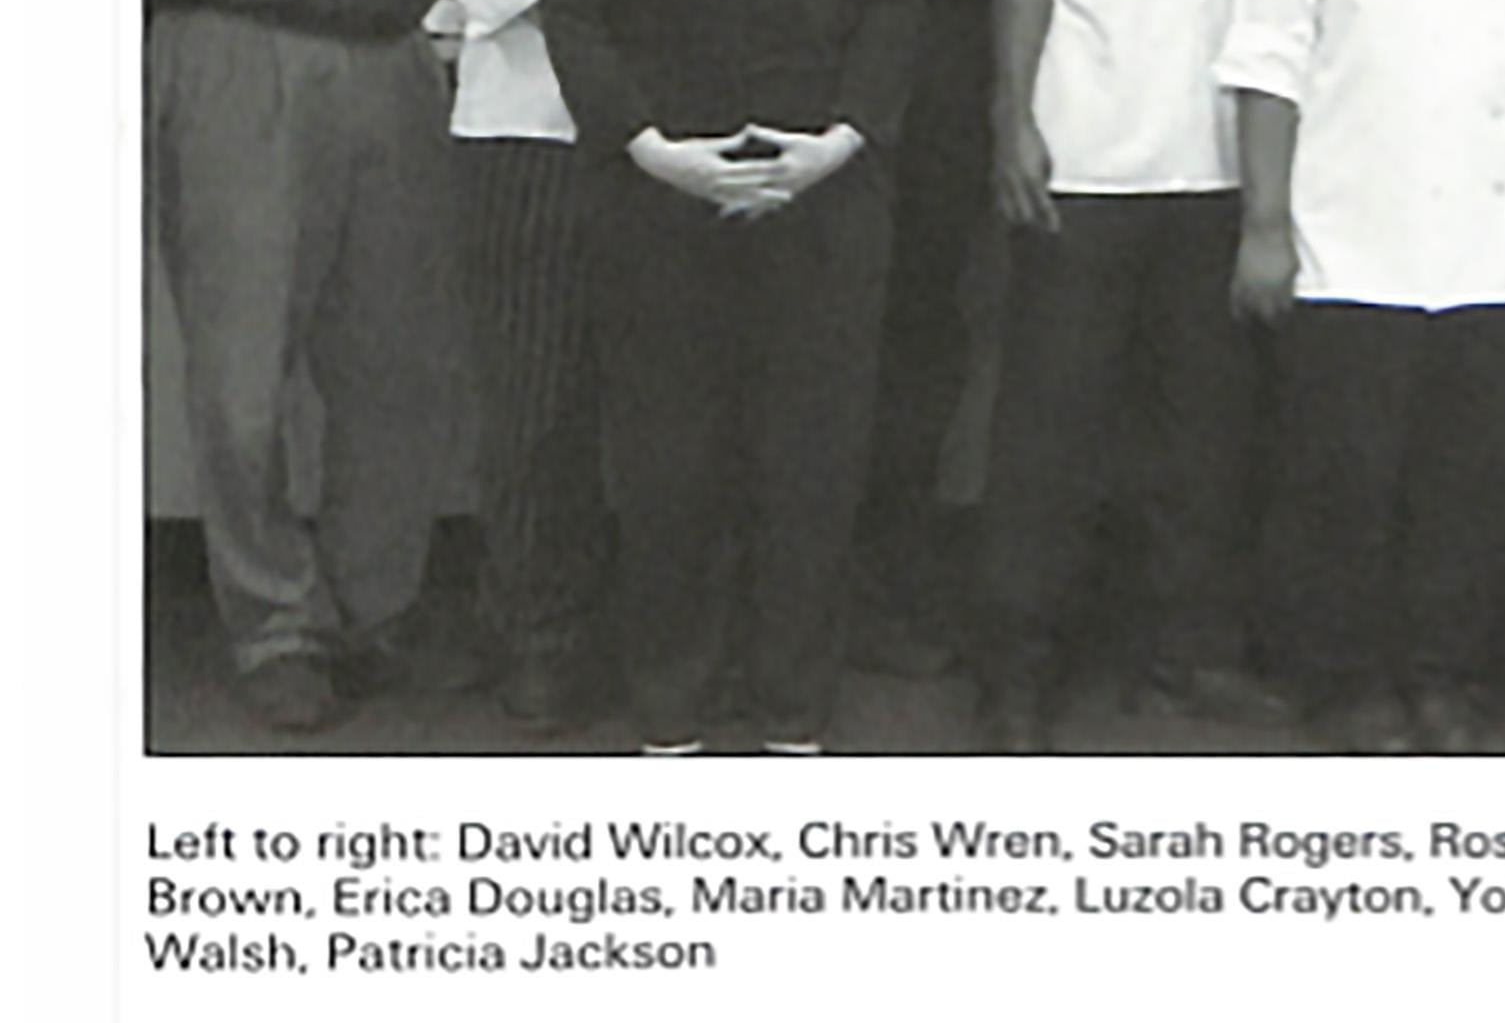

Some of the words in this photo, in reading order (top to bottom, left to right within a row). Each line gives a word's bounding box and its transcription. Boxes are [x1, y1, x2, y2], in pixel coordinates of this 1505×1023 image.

[147, 821, 236, 861] Left
[252, 828, 301, 863] to
[317, 822, 439, 870] right:
[458, 821, 593, 863] David
[607, 821, 783, 862] Wilcox,
[798, 821, 918, 860] Chris
[931, 820, 1073, 862] Wren,
[1089, 820, 1224, 860] Sarah
[1239, 821, 1415, 870] Rogers,
[147, 876, 316, 919] Brown,
[333, 876, 452, 918] Erica
[468, 876, 675, 925] Douglas,
[692, 875, 826, 914] Maria
[842, 875, 1059, 916] Martinez,
[1075, 876, 1224, 914] Luzola
[1238, 875, 1435, 921] Crayton,
[143, 932, 308, 975] Walsh,
[327, 931, 506, 973] Patricia
[519, 932, 716, 972] Jackson
